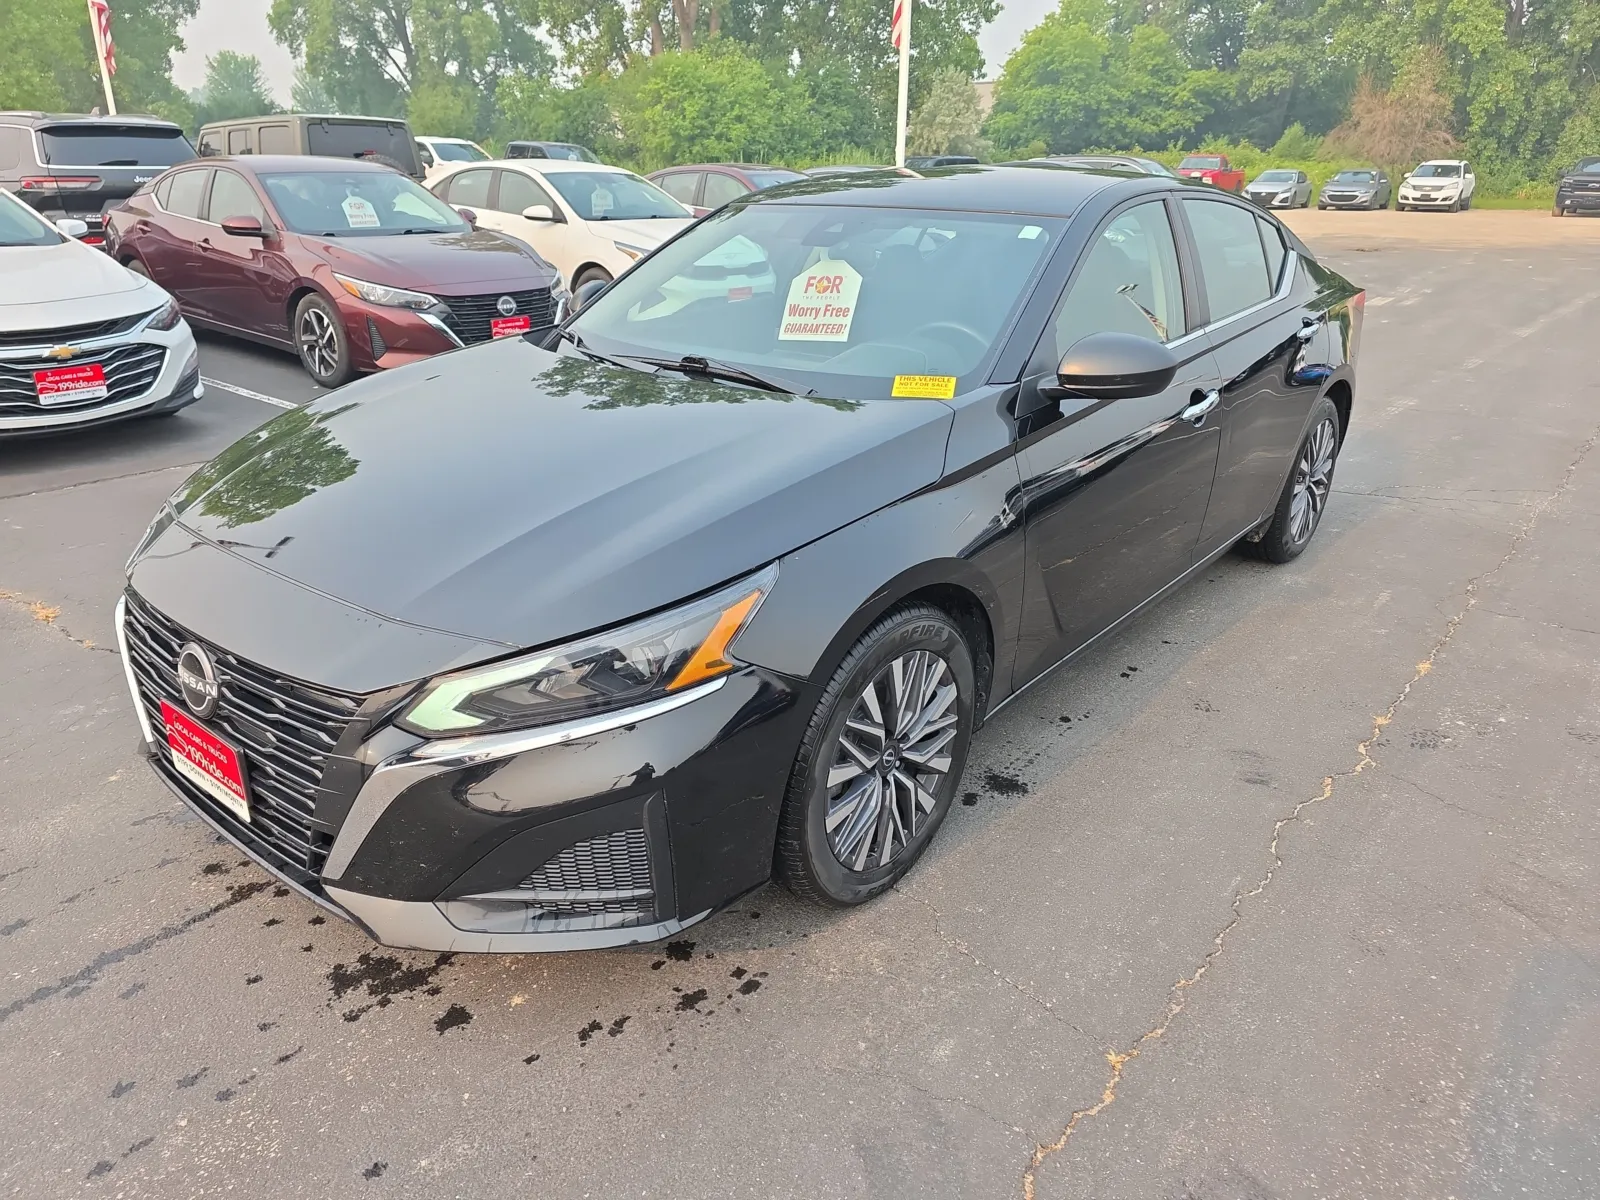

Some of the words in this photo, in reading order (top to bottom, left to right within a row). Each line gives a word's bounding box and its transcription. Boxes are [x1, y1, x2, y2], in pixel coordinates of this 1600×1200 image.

[803, 275, 844, 294] FOR
[788, 303, 822, 320] Worry
[822, 303, 850, 318] Free
[783, 322, 848, 335] GUARANTEED!
[57, 379, 104, 391] 199ride.com
[918, 376, 953, 384] VEHICLE
[180, 663, 217, 697] SSAN
[173, 720, 190, 738] LOCAL
[187, 745, 244, 797] 199ride.com
